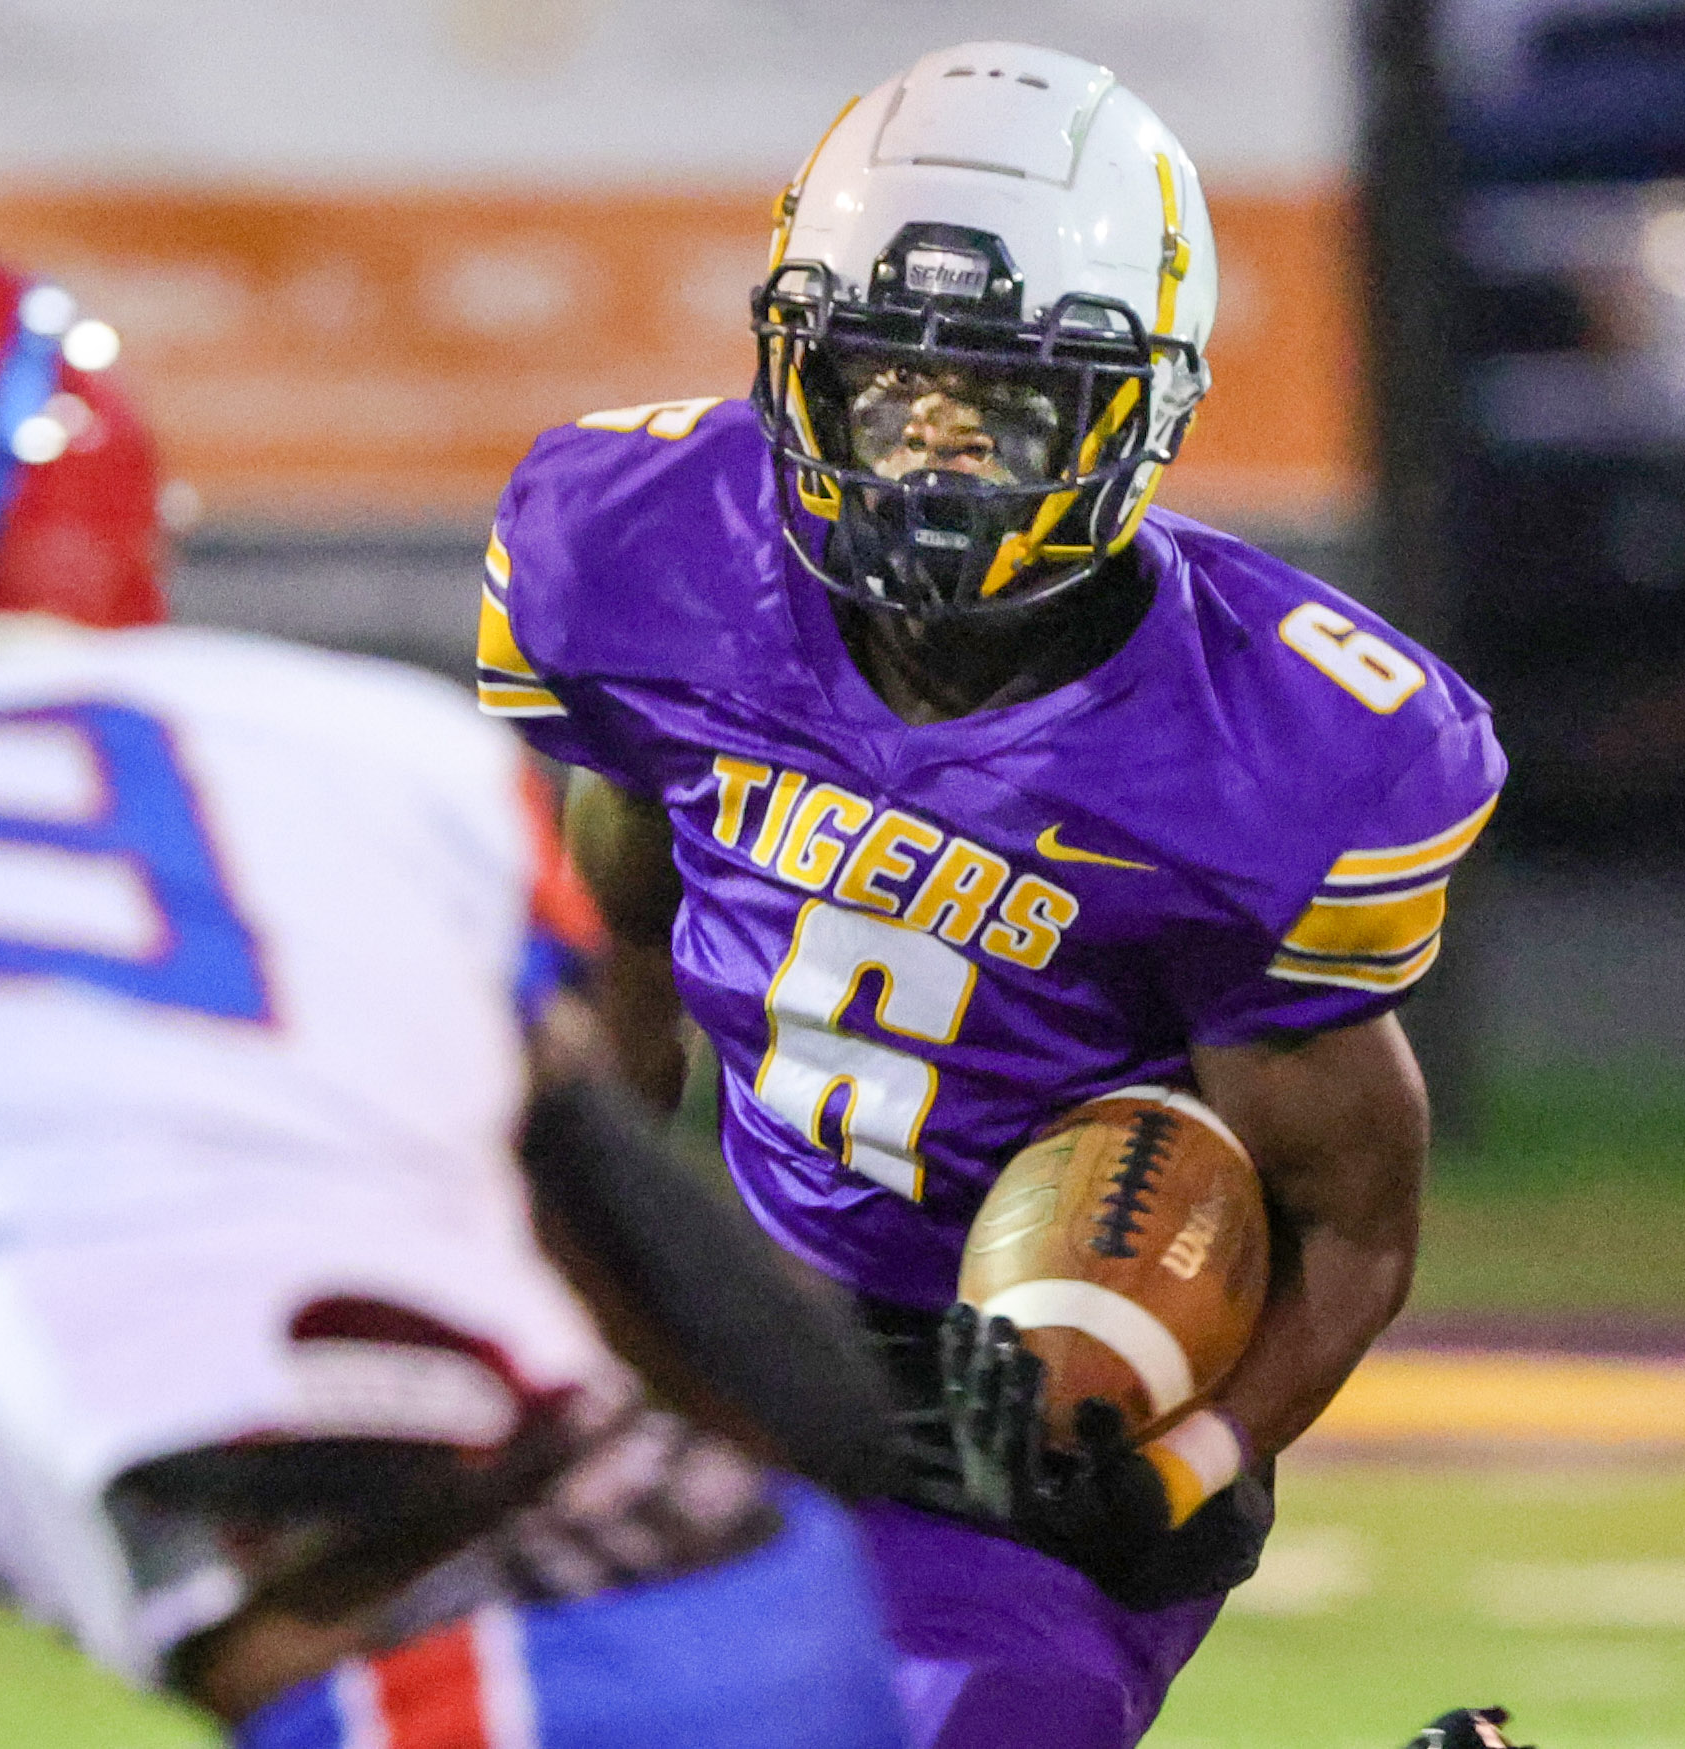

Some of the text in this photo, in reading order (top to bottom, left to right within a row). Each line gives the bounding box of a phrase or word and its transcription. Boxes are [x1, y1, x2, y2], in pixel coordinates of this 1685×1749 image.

[1278, 601, 1427, 715] 6
[712, 754, 1079, 970] TIGERS
[754, 897, 979, 1203] 6
